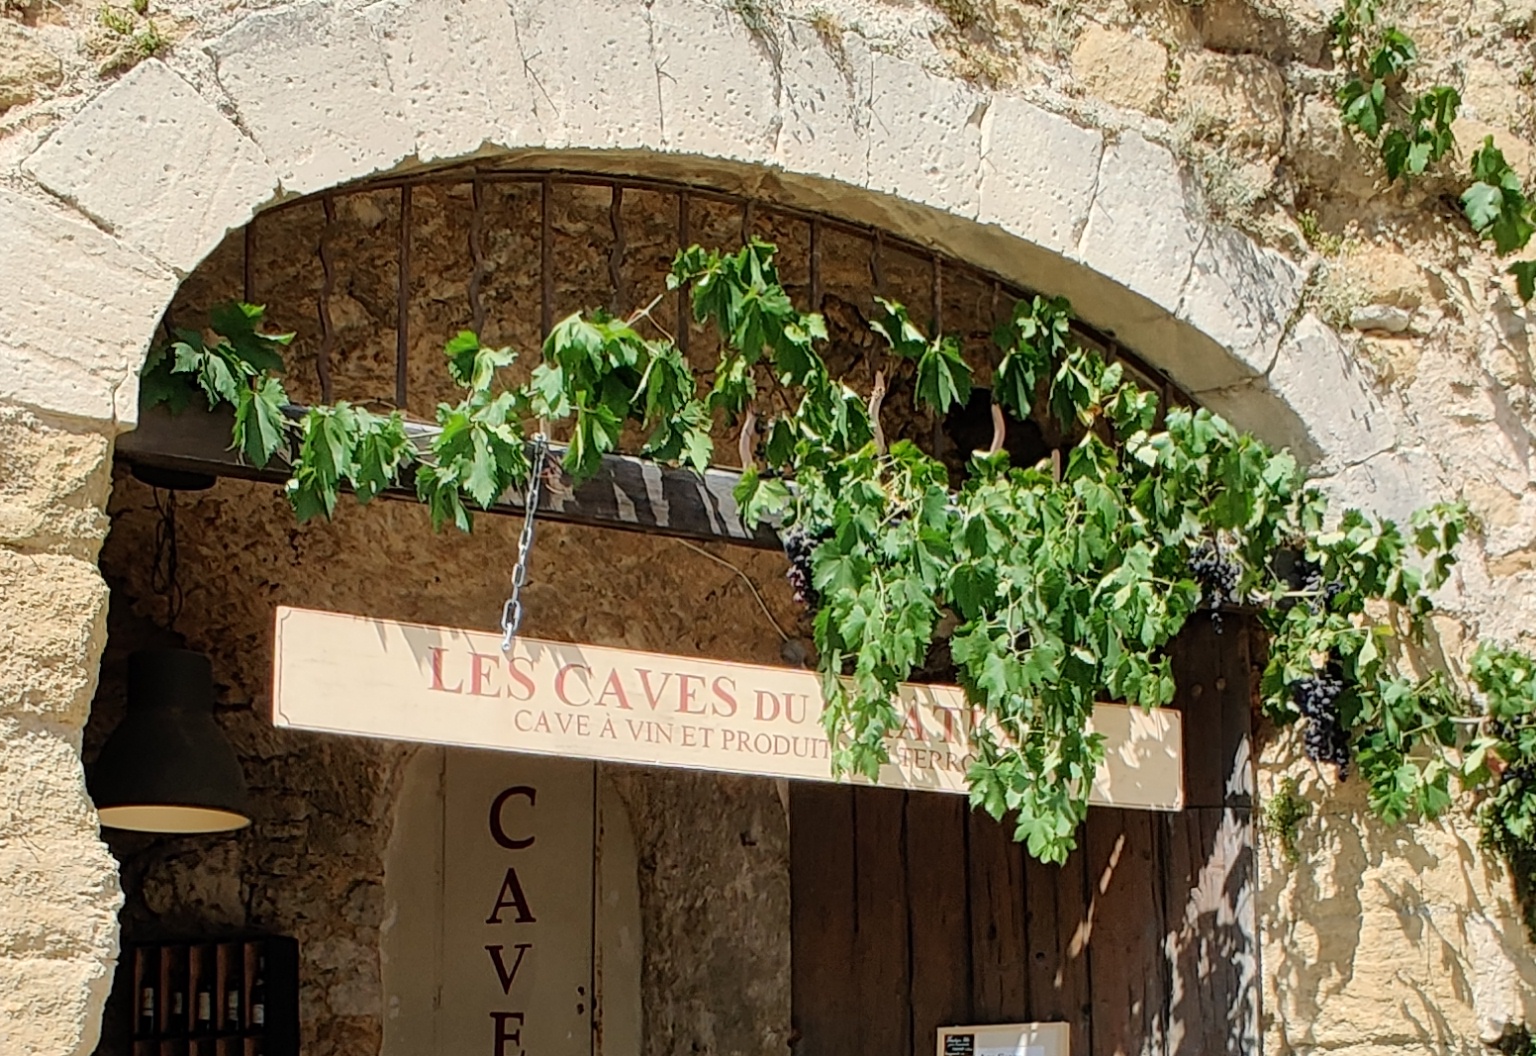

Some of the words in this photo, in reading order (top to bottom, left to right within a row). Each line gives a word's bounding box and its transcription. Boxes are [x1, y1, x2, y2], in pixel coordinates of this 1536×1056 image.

[428, 646, 537, 701] LES
[554, 662, 738, 719] CAVES
[753, 690, 810, 725] DU
[514, 709, 591, 737] CAVE
[599, 712, 618, 740] À
[625, 718, 673, 745] VIN
[681, 724, 715, 748] ET
[721, 728, 830, 760] PRODUIT
[900, 746, 978, 774] TERRO
